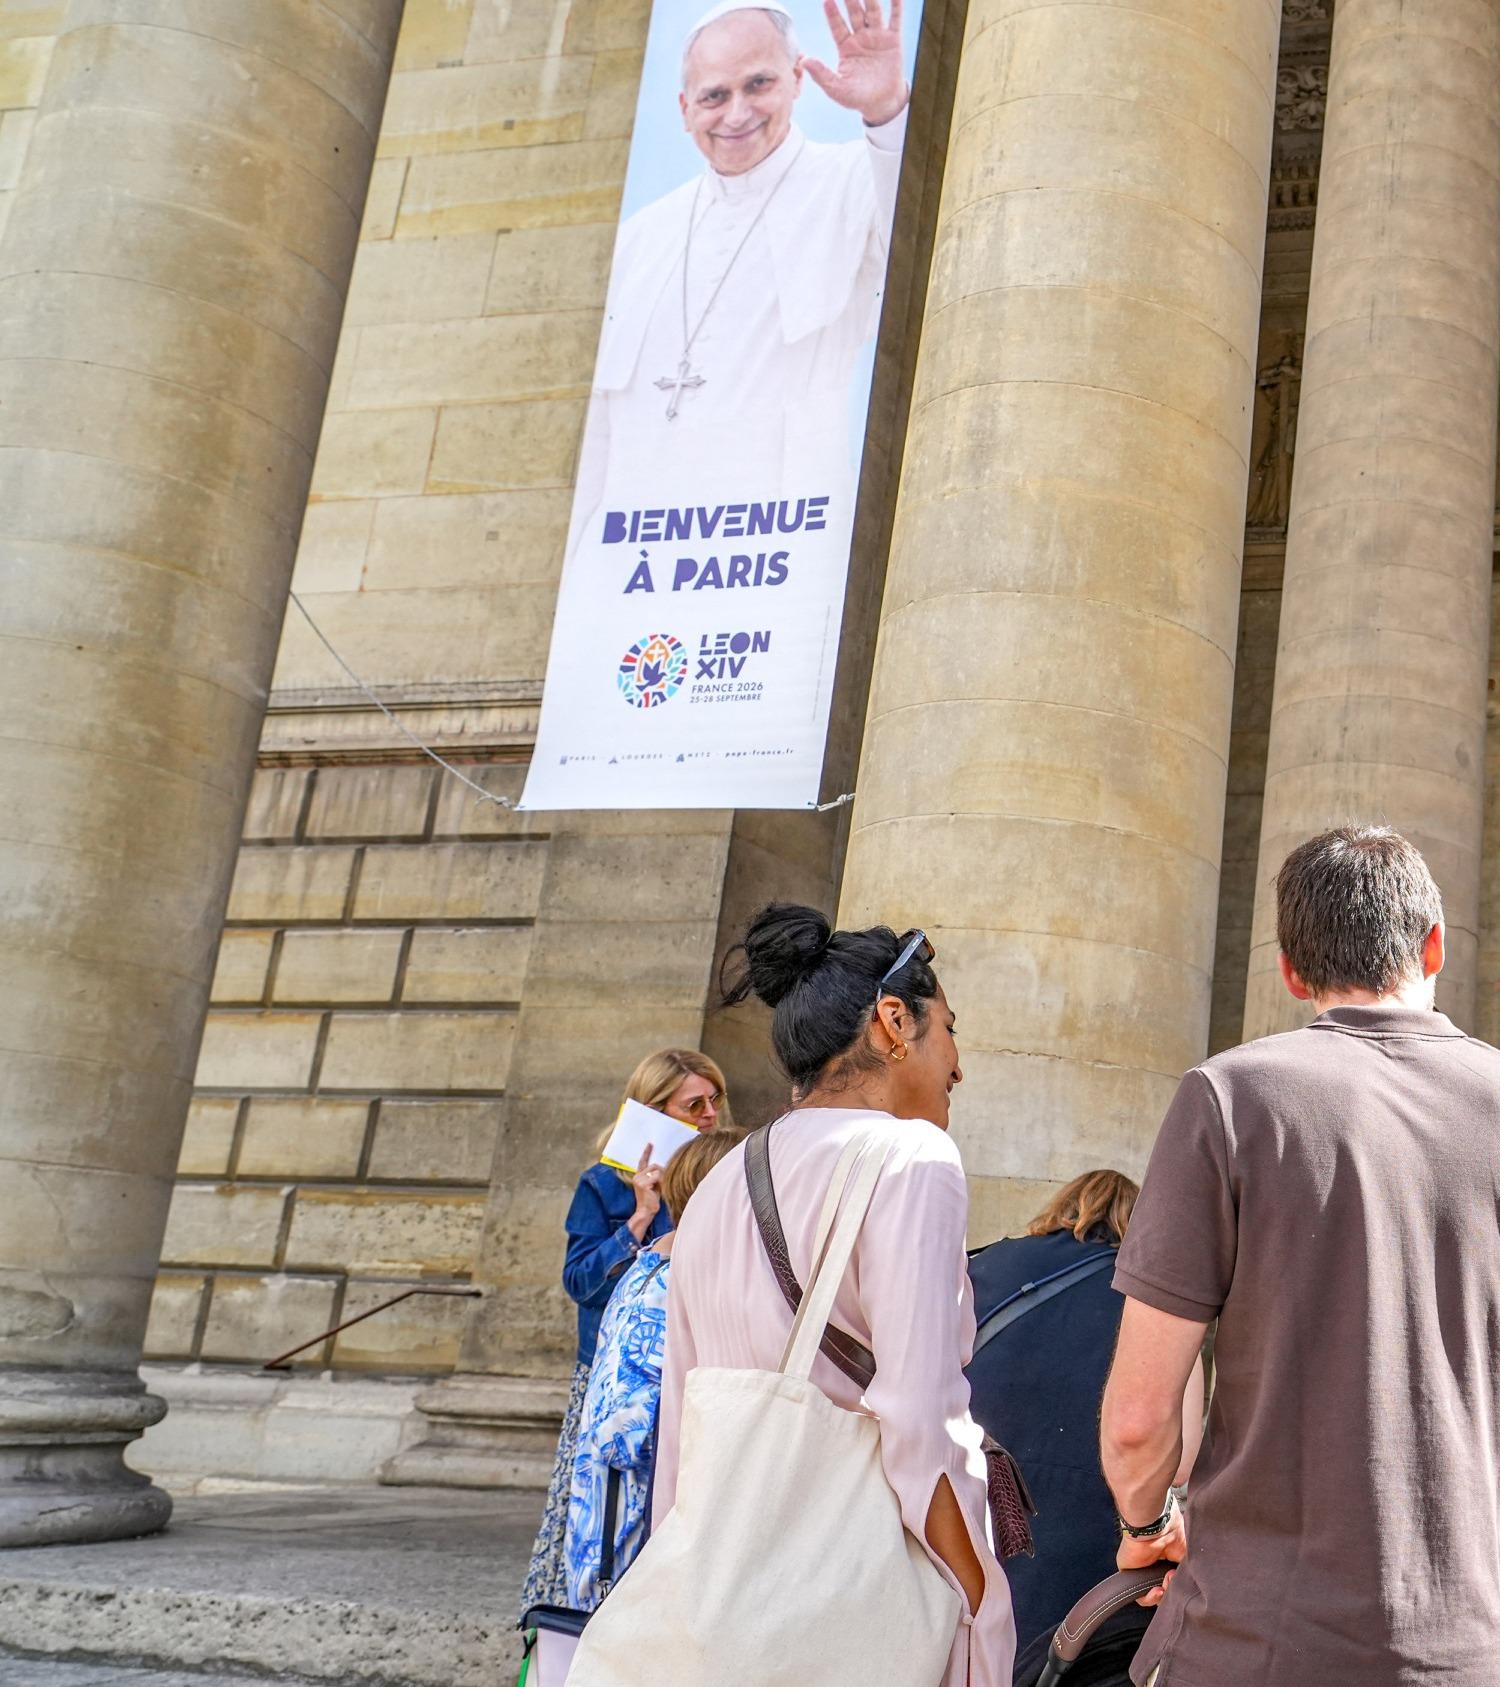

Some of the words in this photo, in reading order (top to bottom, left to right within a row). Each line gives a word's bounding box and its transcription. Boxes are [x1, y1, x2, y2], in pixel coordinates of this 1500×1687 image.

[602, 496, 830, 544] BIENVENUE
[623, 549, 655, 593] À
[672, 551, 790, 591] PARIS
[699, 631, 771, 656] LEON
[695, 656, 747, 680] XIV
[691, 683, 733, 694] FRANCE
[737, 682, 763, 692] 2026
[715, 693, 761, 703] SEPTEMBRE
